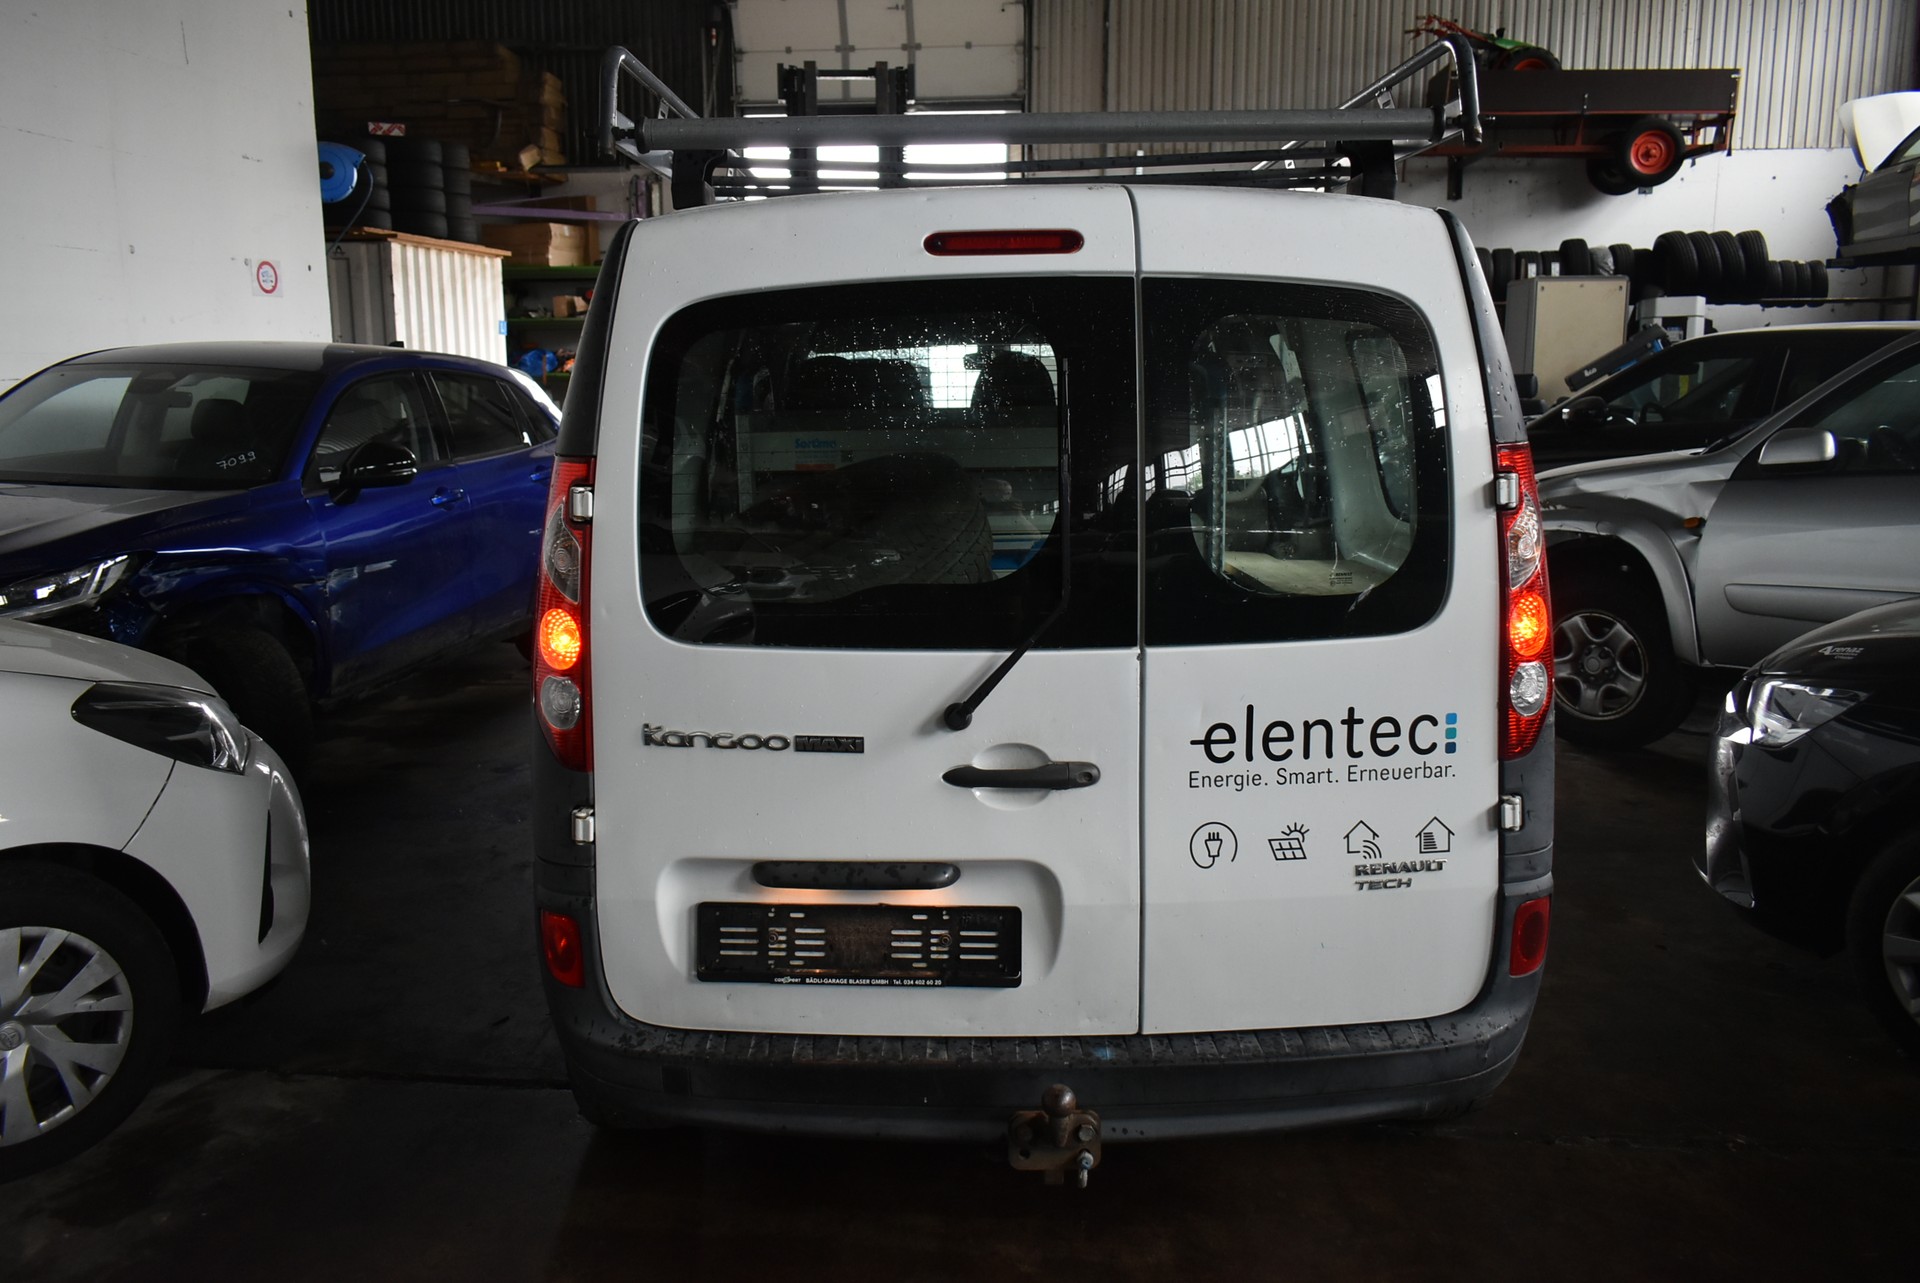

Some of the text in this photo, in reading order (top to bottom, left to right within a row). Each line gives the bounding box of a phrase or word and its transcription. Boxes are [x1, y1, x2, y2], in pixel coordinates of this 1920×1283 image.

[215, 450, 257, 469] 7099
[643, 723, 791, 751] Kangoo
[1190, 703, 1439, 764] elentec
[1189, 760, 1457, 792] Energie. Smart. Erneuerbar.
[1354, 859, 1447, 877] RENAULT
[1354, 877, 1413, 891] TECH
